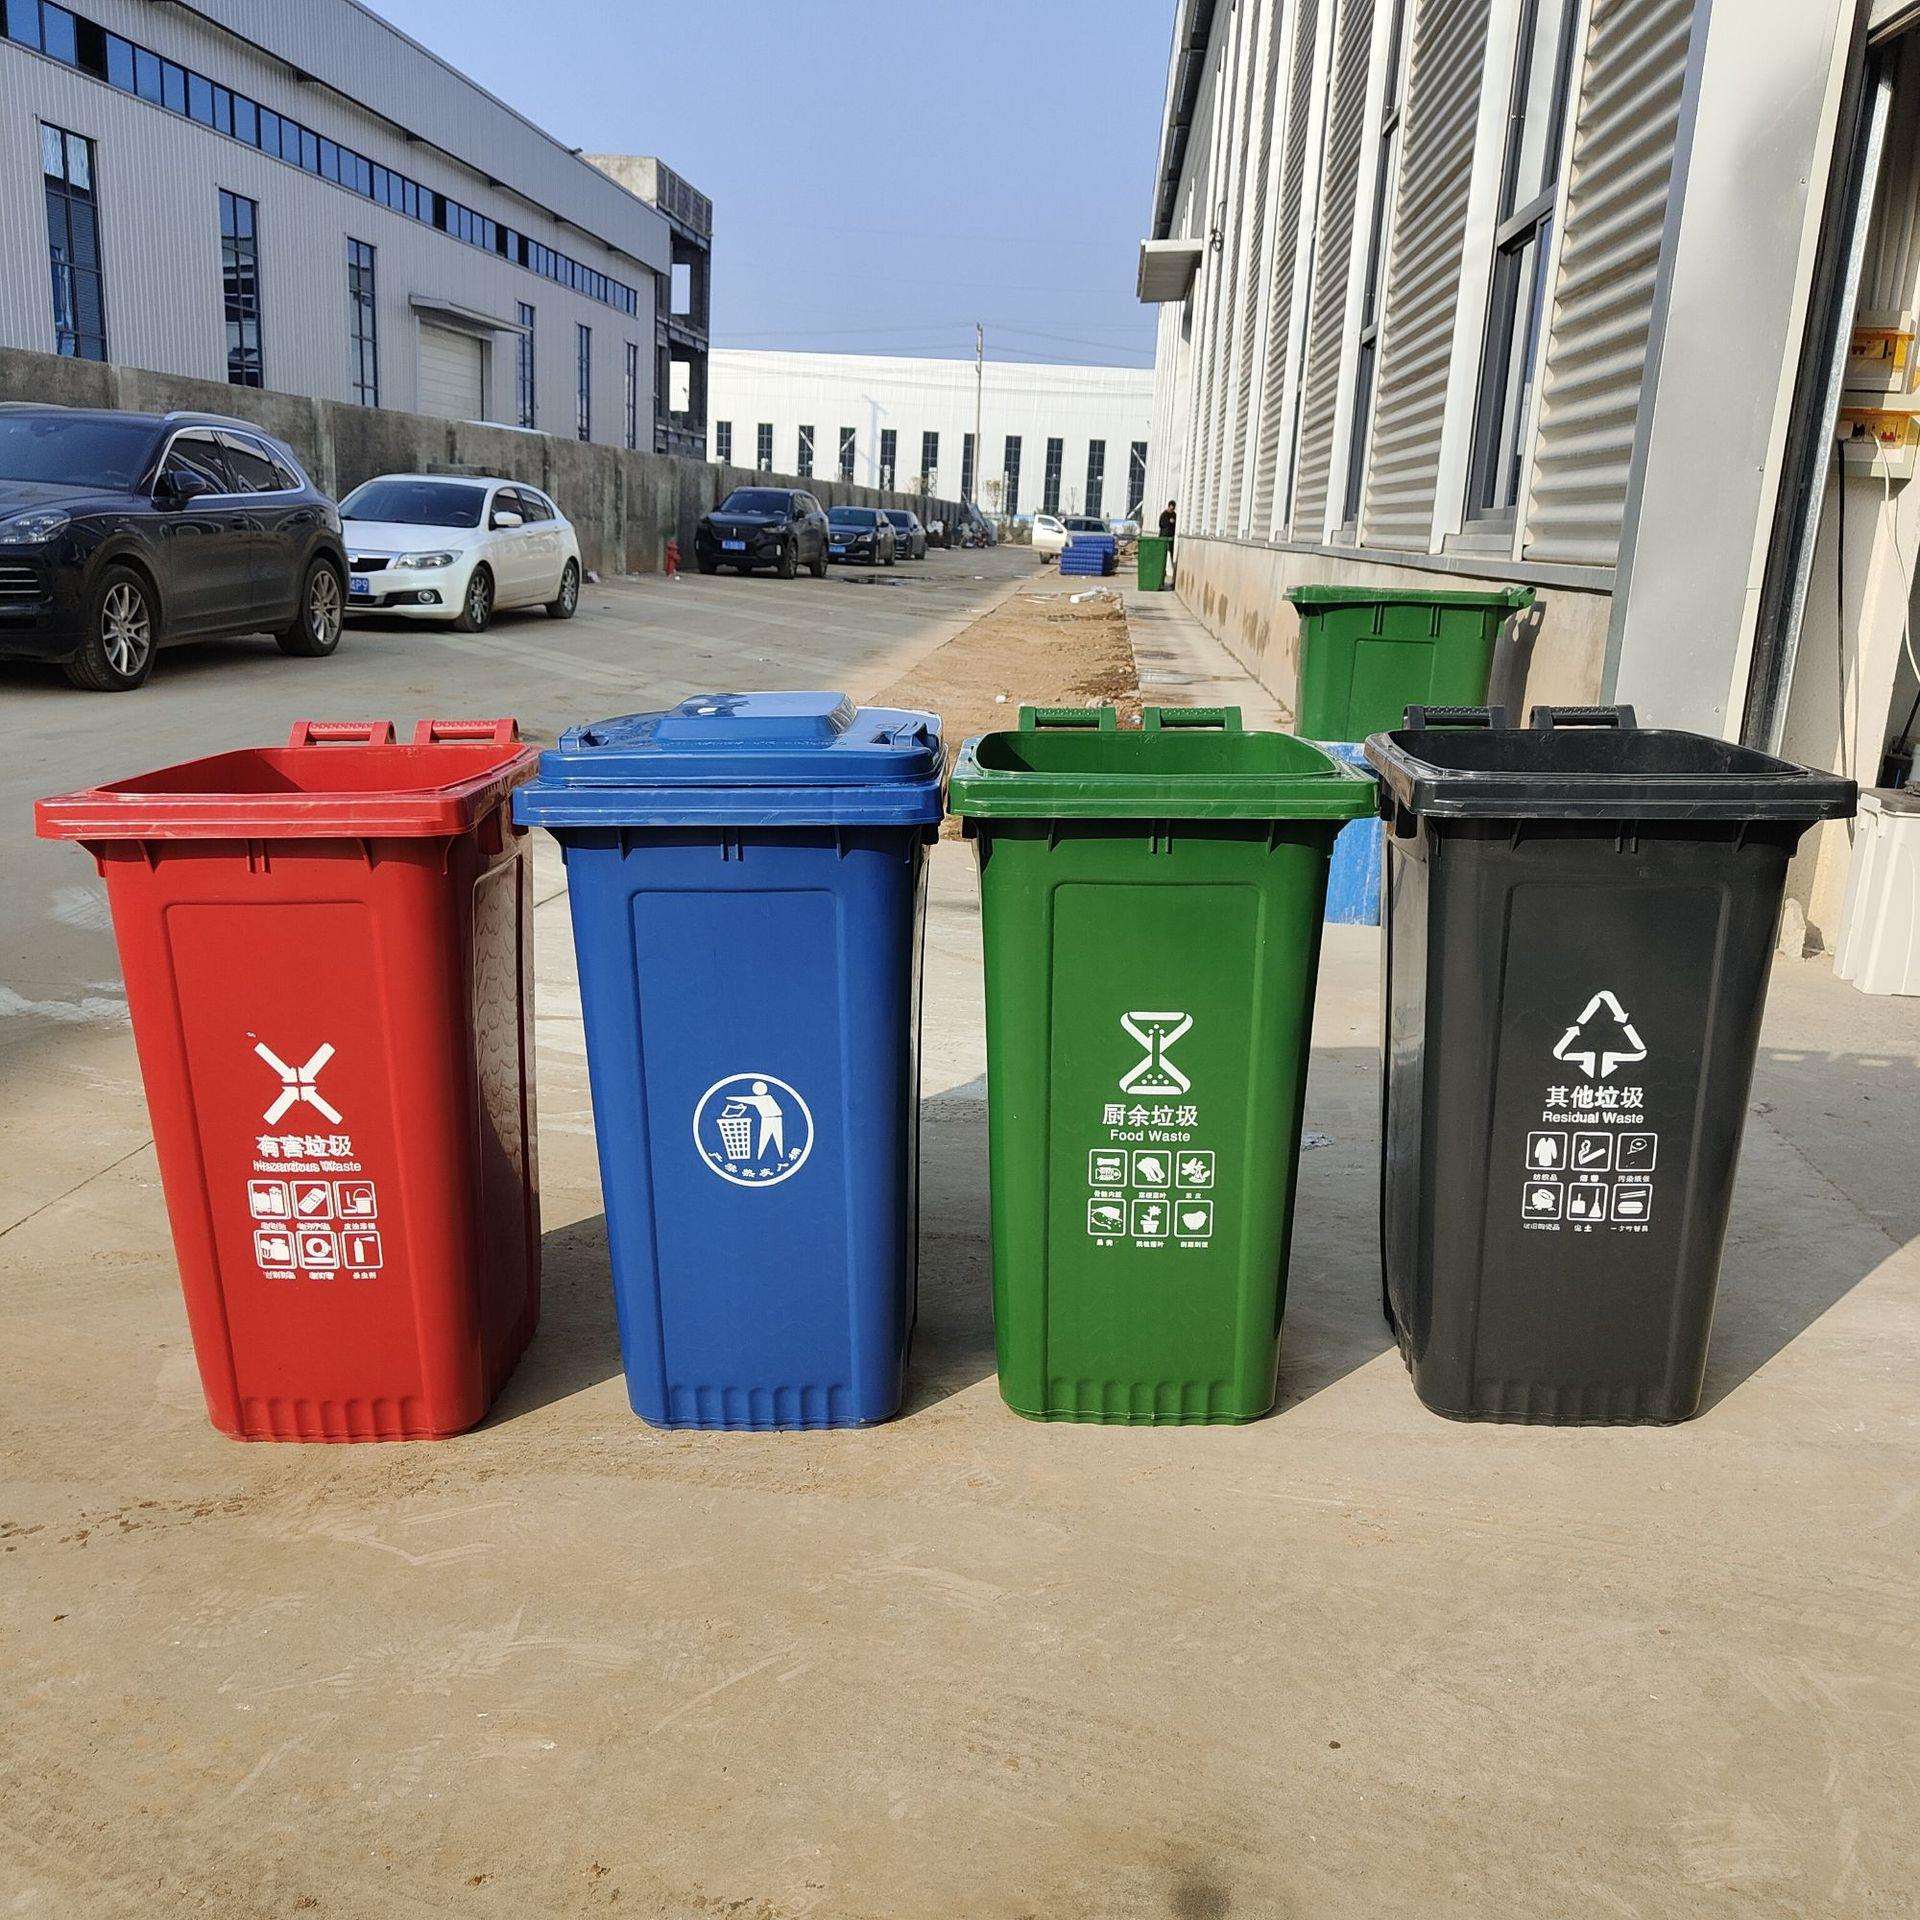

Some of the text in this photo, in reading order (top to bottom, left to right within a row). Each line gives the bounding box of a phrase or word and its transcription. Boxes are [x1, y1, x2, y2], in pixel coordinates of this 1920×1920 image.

[1545, 1085, 1643, 1108] 其他垃圾
[1102, 1104, 1198, 1127] 厨余垃圾
[1543, 1111, 1643, 1123] Residual Waste
[1111, 1129, 1190, 1141] Food Waste
